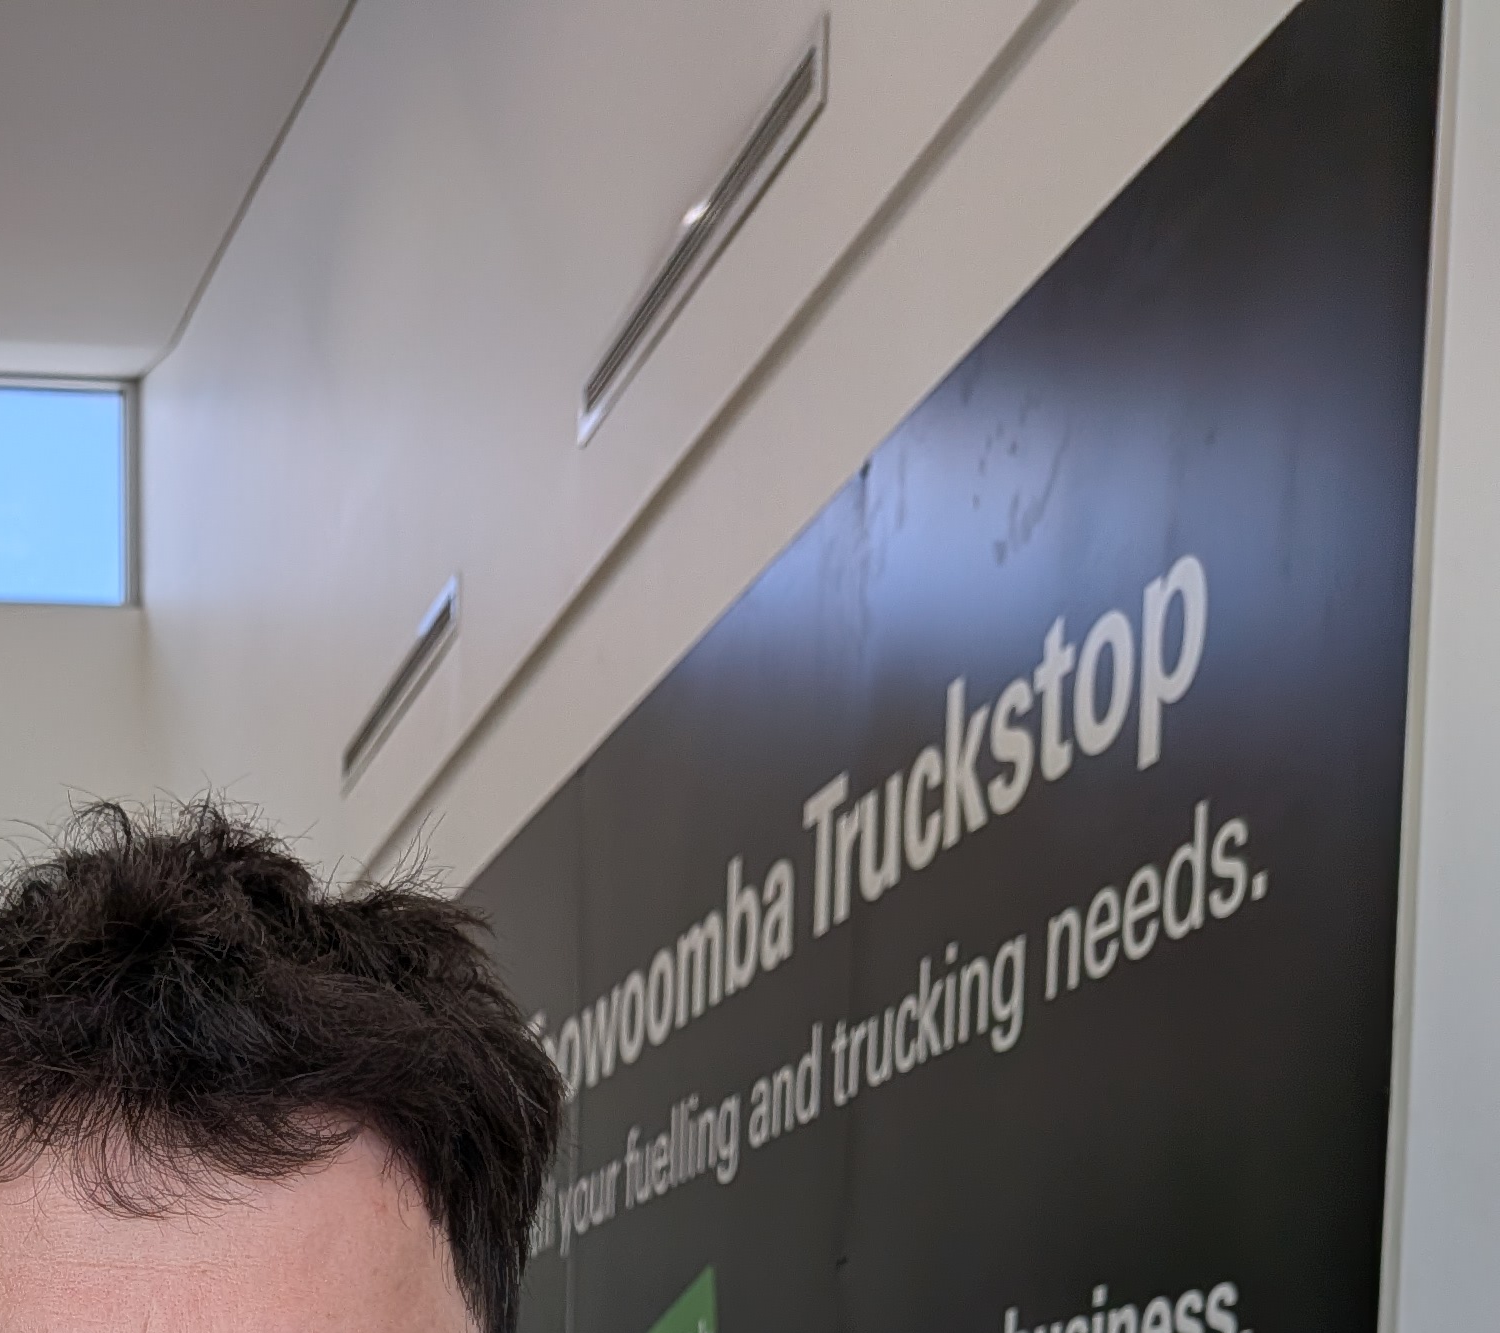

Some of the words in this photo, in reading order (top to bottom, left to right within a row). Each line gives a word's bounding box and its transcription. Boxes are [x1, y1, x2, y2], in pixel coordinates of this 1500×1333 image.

[527, 855, 795, 1099] owoomba
[803, 555, 1208, 938] Truckstop
[559, 1160, 621, 1257] your
[625, 1093, 740, 1185] fuelling
[749, 1021, 823, 1149] and
[832, 934, 1027, 1107] trucking
[1045, 799, 1269, 1000] needs.
